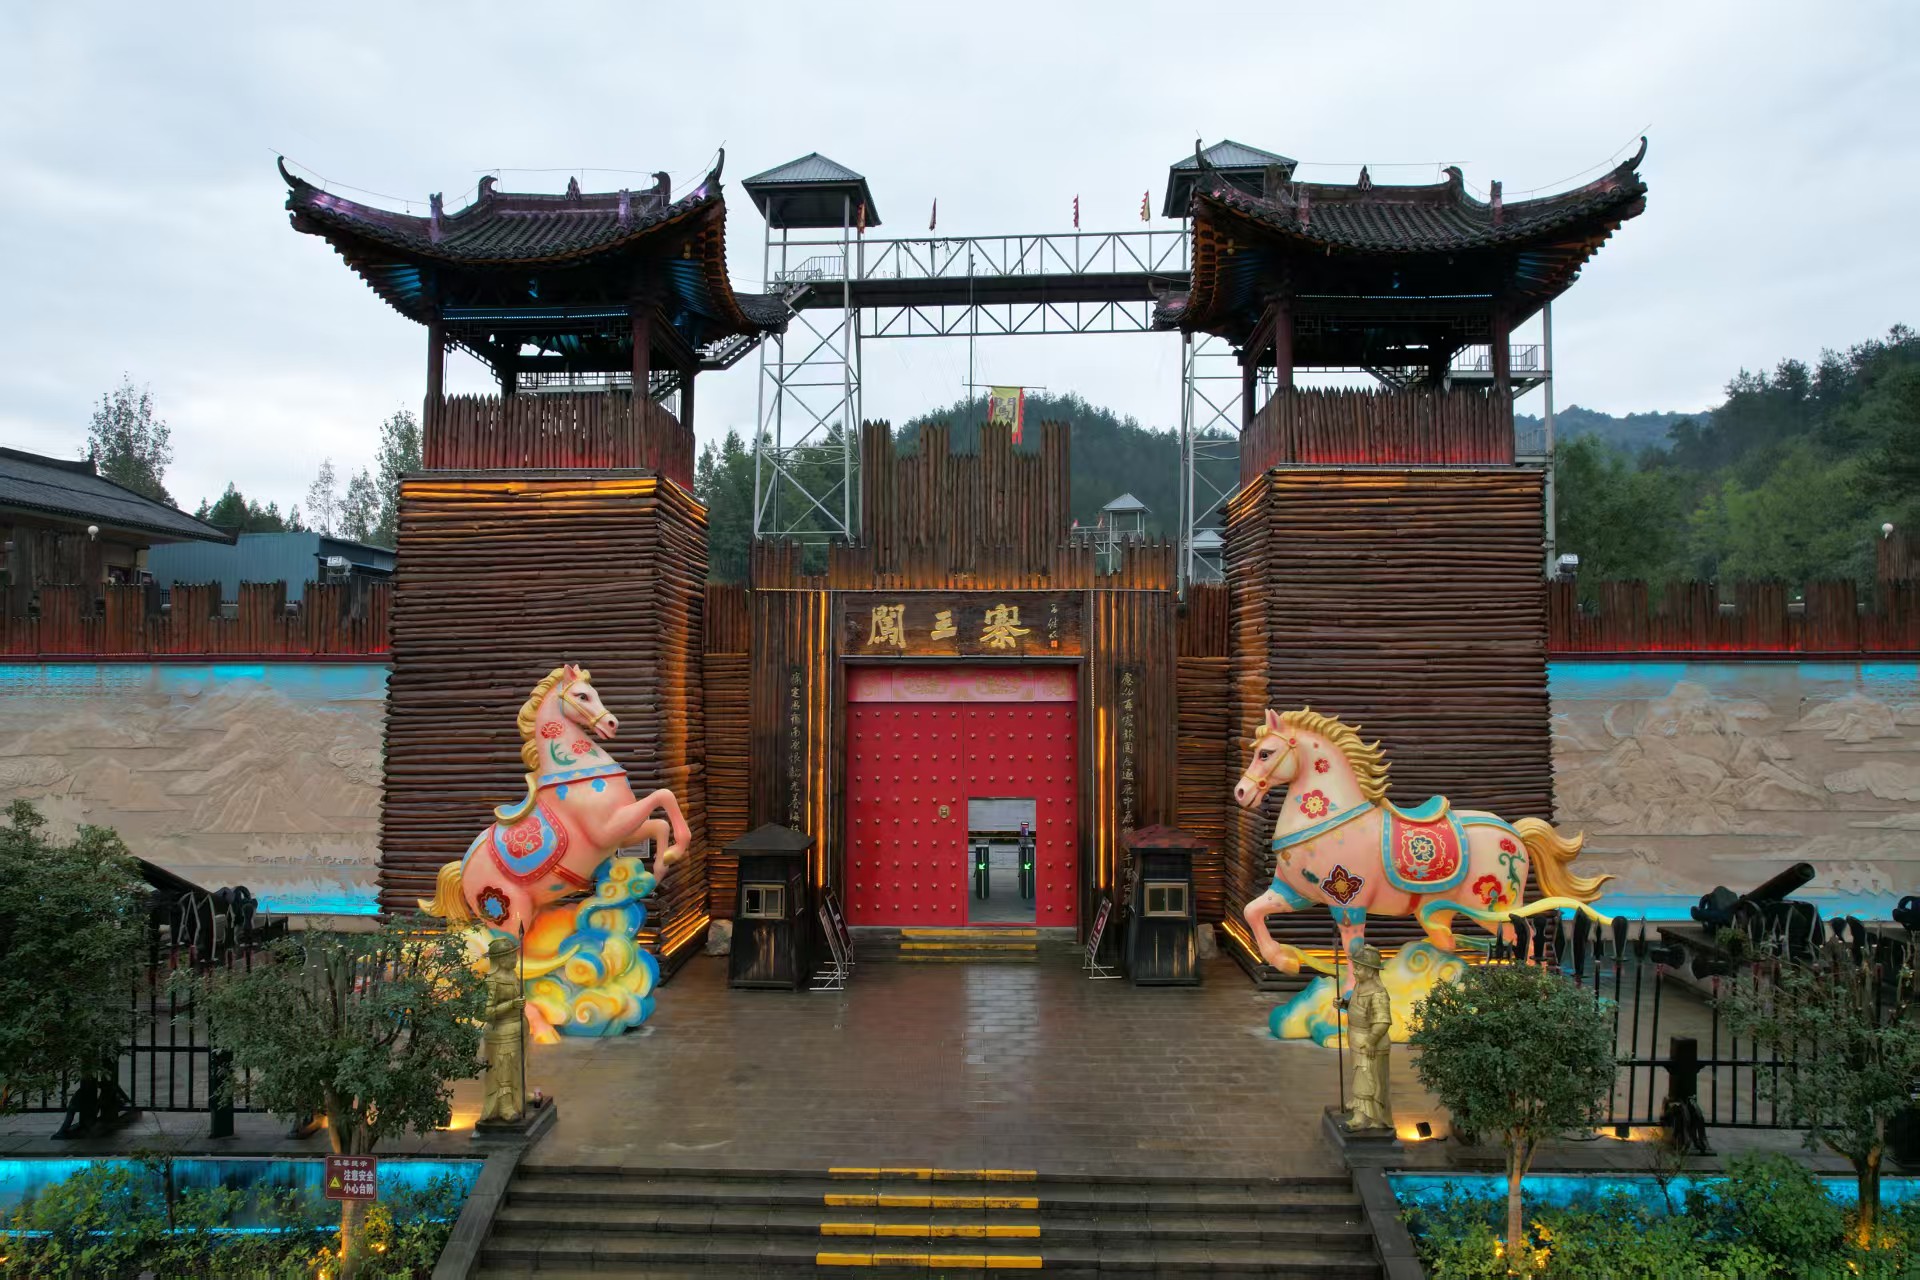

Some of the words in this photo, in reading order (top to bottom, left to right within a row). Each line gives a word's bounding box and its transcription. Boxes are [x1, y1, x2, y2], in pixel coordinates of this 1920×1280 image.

[343, 1169, 374, 1182] 注意安全
[343, 1182, 374, 1195] 小心台阶
